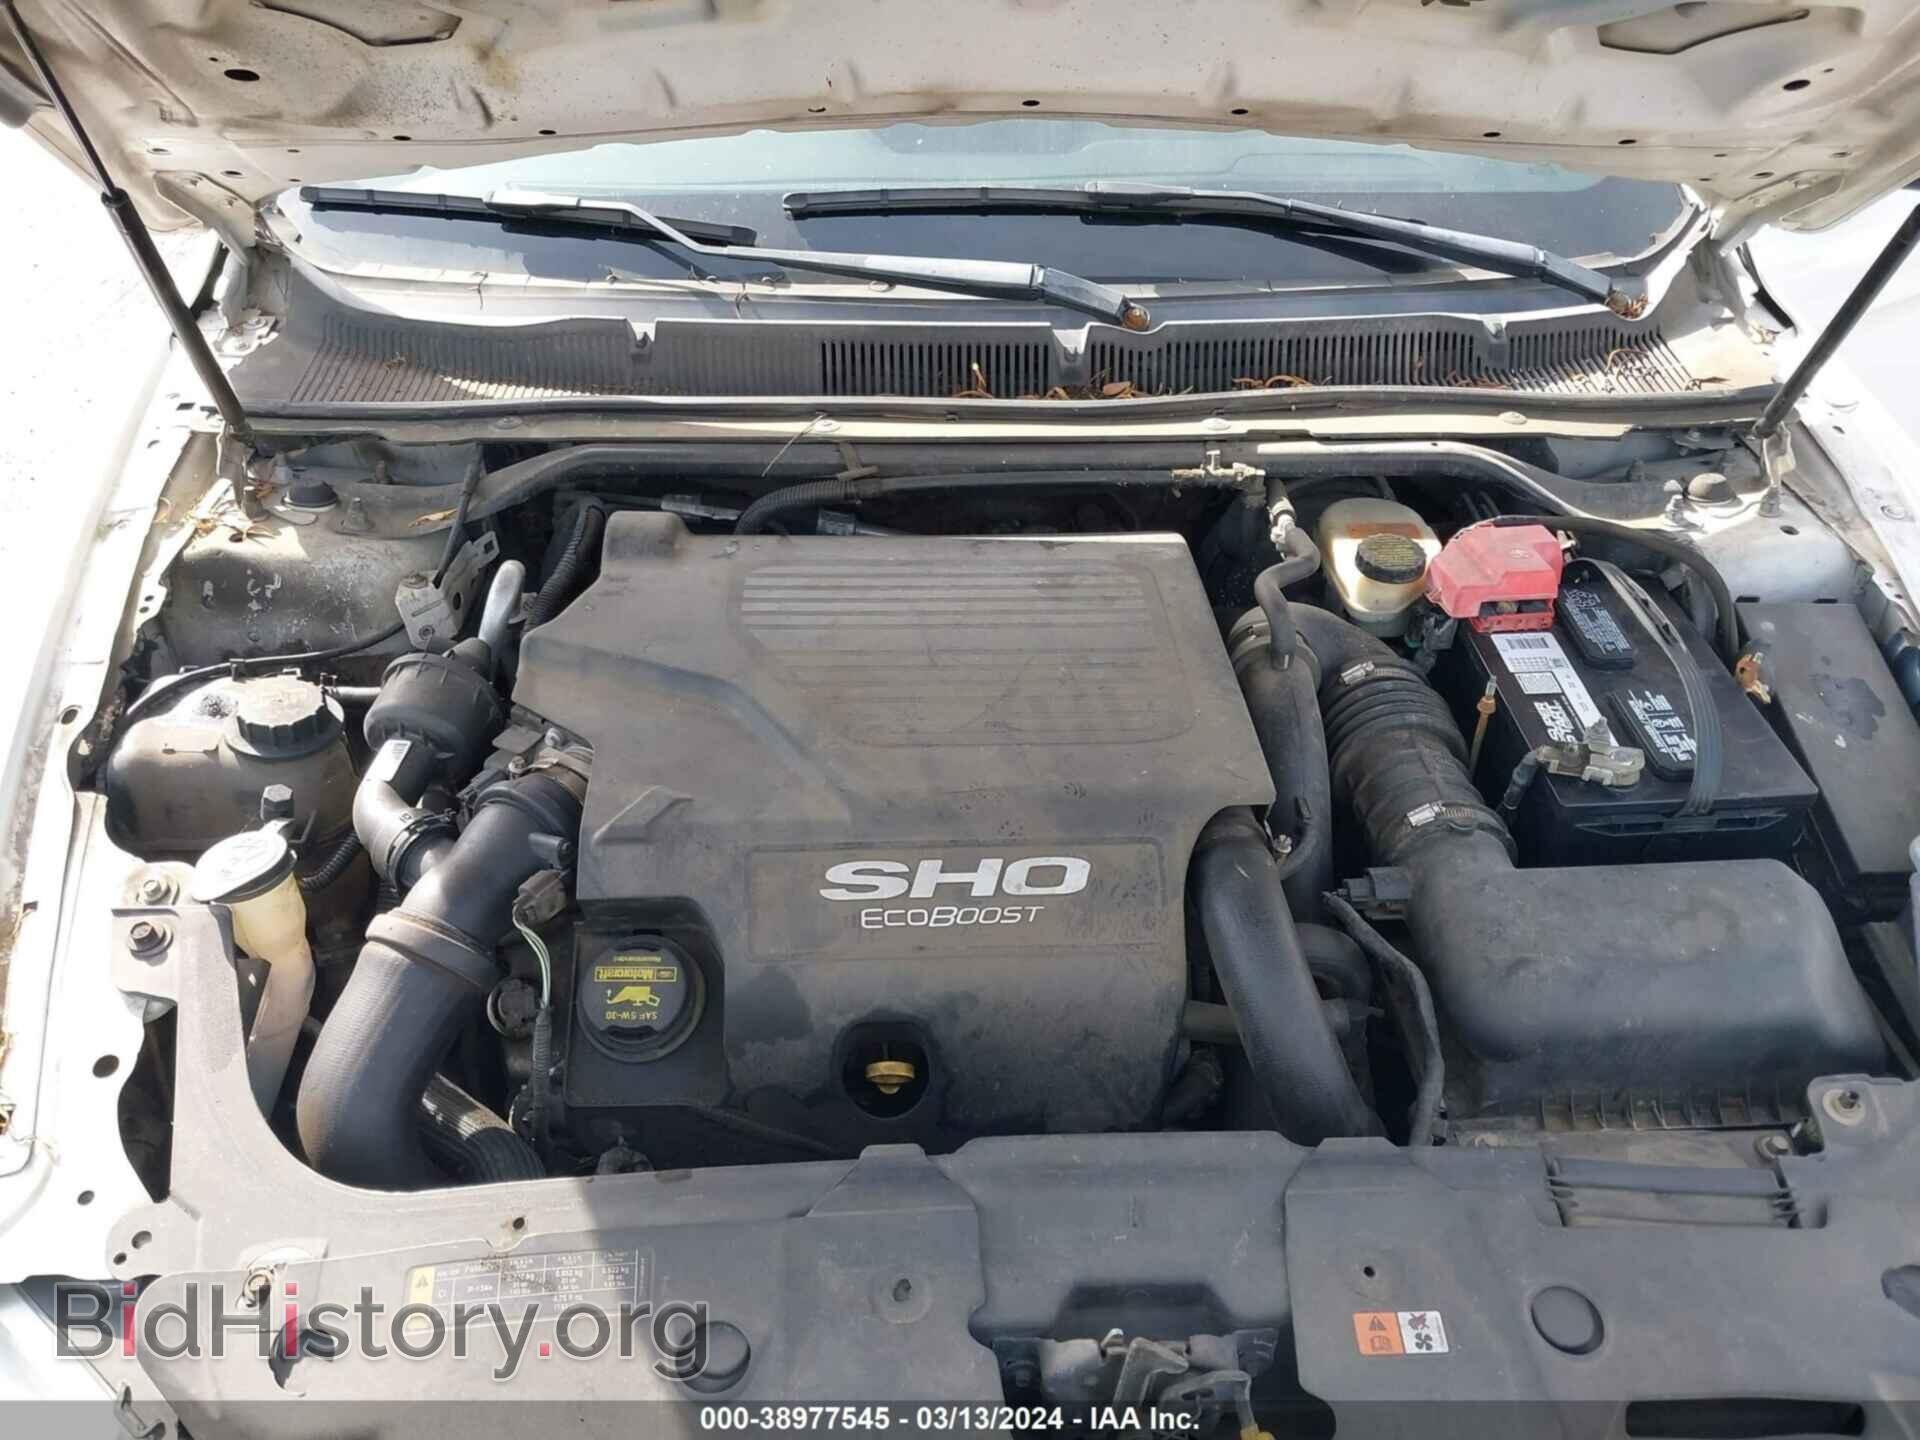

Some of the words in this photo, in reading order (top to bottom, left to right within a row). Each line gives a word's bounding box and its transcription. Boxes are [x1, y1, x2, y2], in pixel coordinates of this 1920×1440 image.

[1533, 701, 1559, 741] SUPER
[818, 856, 1092, 901] SHO
[599, 967, 653, 979] Motorcraft
